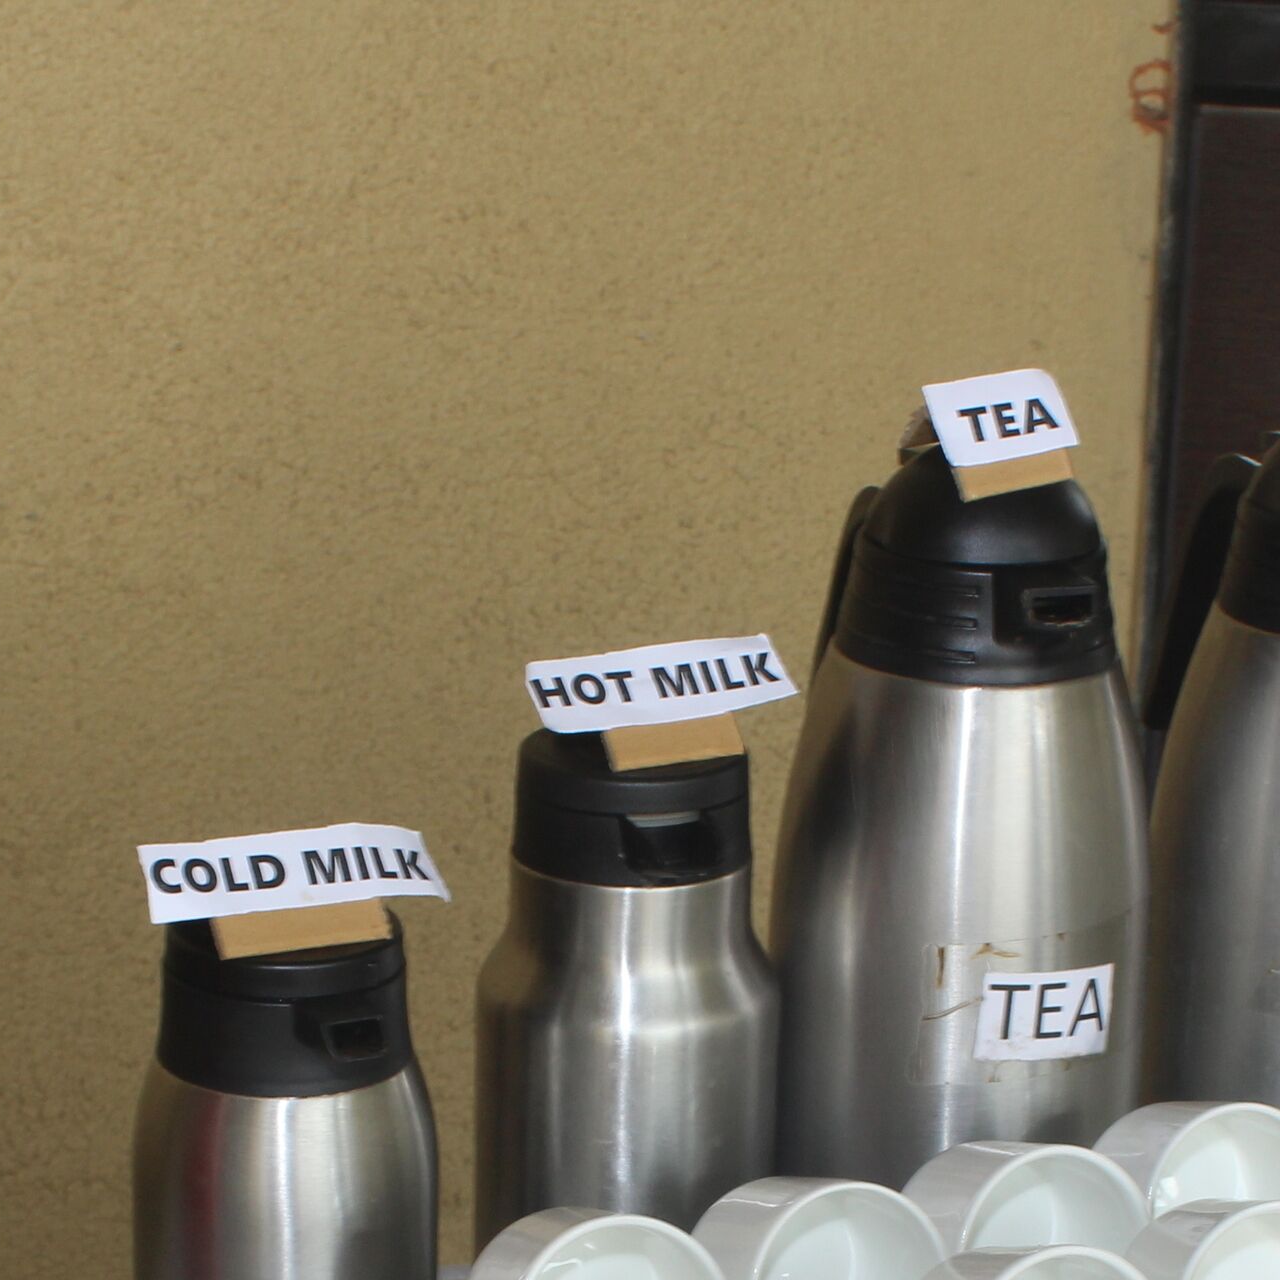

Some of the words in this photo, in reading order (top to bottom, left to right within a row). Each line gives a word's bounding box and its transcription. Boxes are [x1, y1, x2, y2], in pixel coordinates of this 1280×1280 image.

[958, 397, 1060, 443] TEA
[529, 670, 634, 709] HOT
[651, 652, 782, 699] MILK
[150, 854, 287, 895] COLD
[304, 845, 431, 886] MILK
[988, 977, 1108, 1041] TEA
